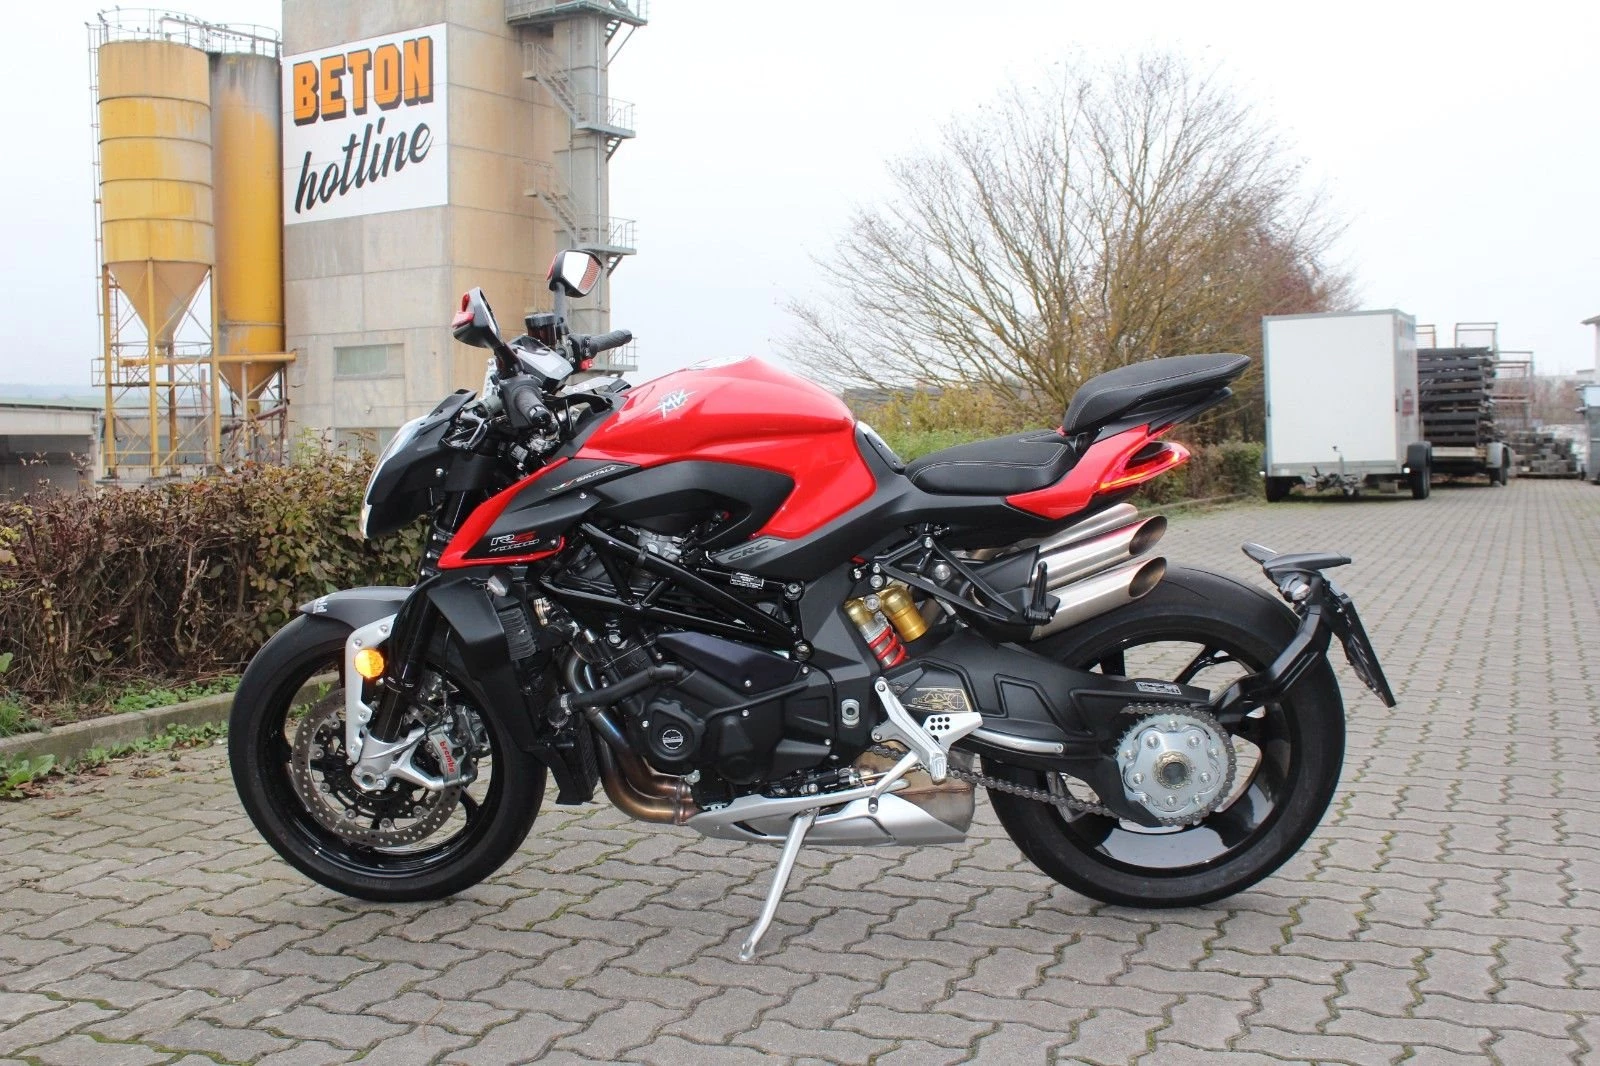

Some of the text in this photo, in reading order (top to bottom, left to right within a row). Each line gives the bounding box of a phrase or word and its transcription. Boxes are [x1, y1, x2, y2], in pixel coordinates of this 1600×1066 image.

[293, 36, 434, 127] BETON
[294, 116, 434, 214] hotline
[728, 541, 769, 560] CRC
[439, 739, 456, 774] brembo
